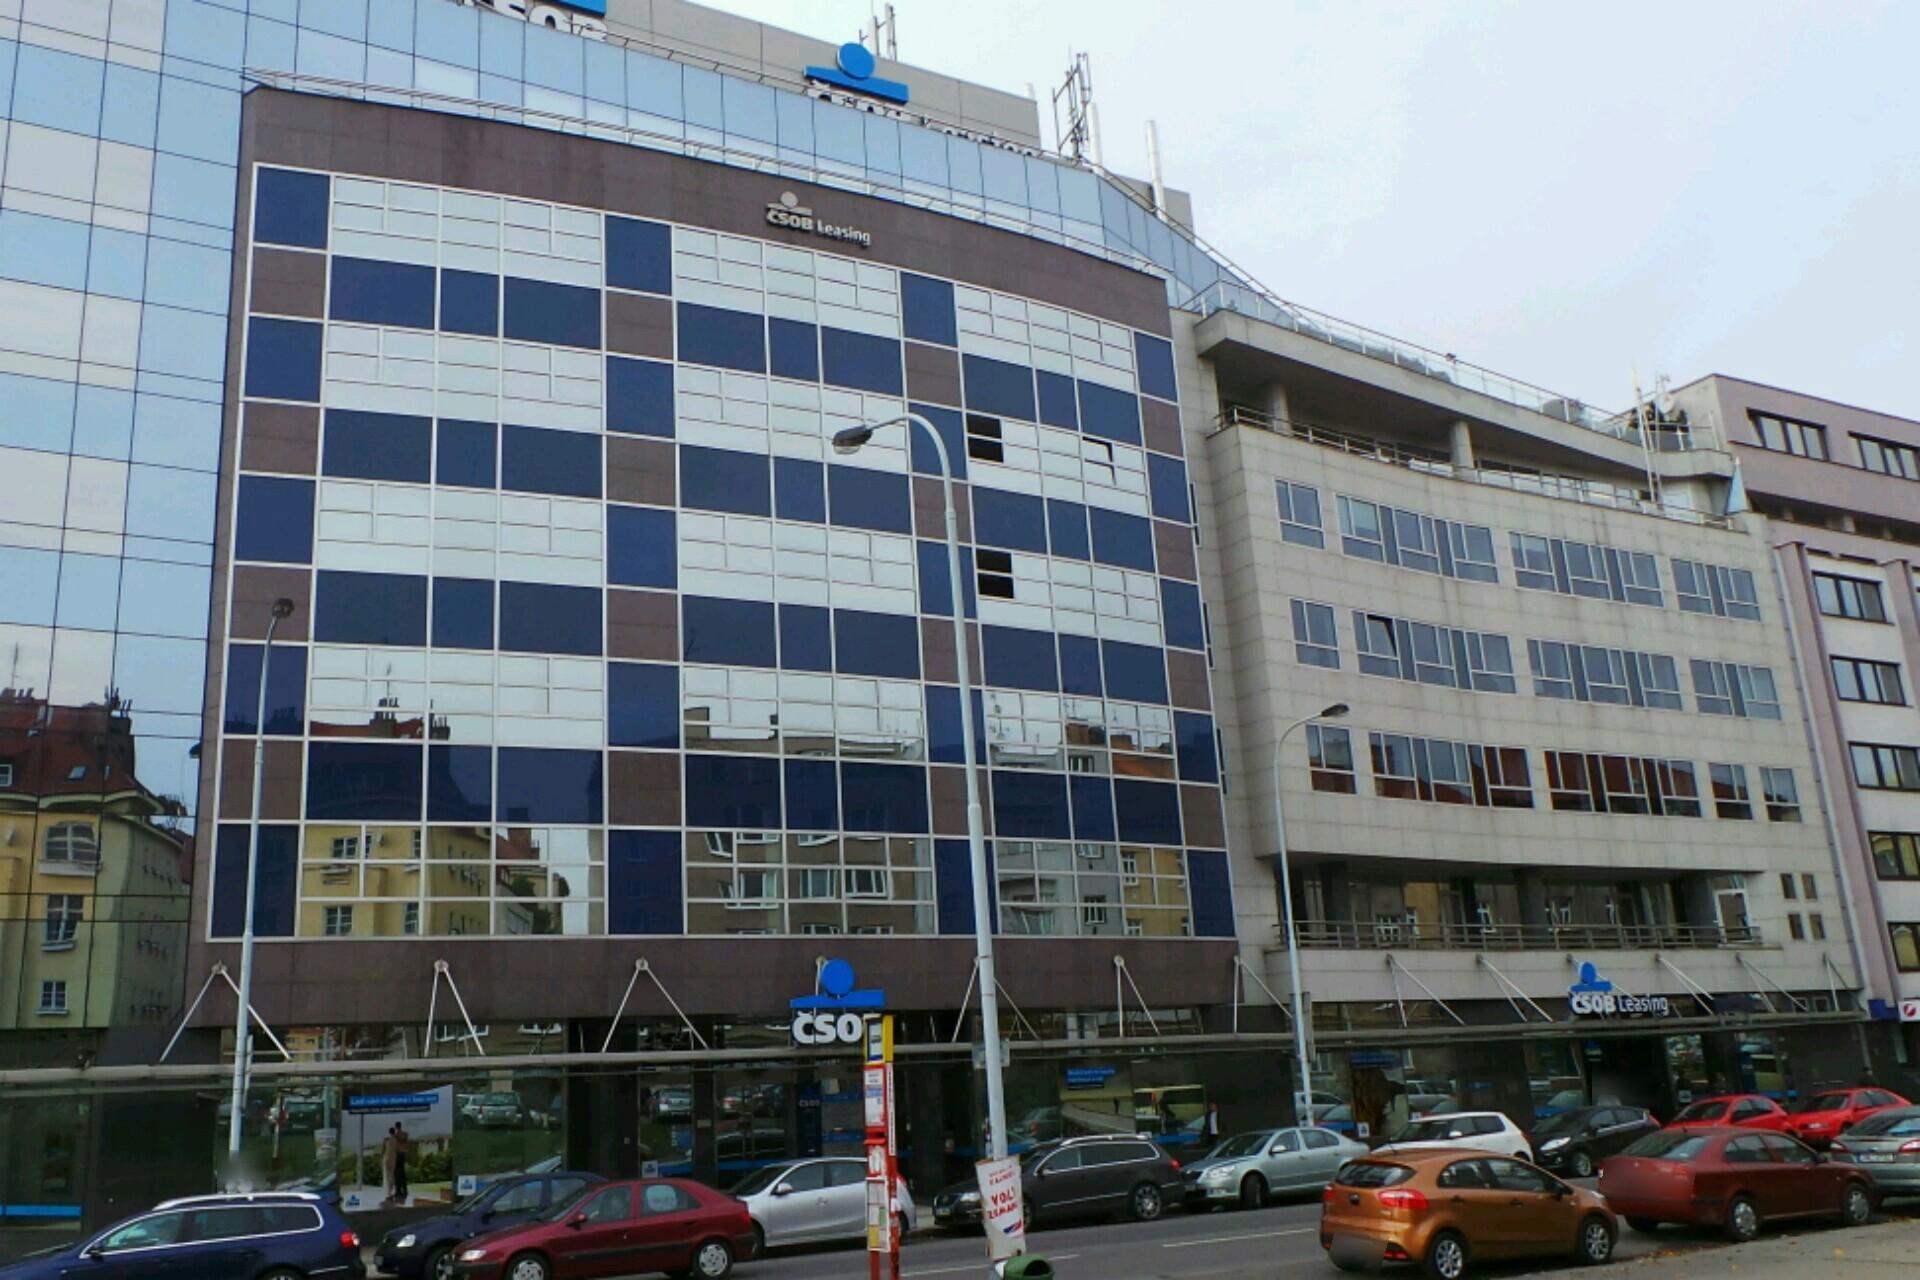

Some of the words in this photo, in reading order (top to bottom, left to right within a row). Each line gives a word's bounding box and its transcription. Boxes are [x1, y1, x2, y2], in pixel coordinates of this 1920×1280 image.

[817, 219, 871, 246] Leasing
[1619, 993, 1669, 1017] Leasing
[792, 1011, 864, 1044] ČSO
